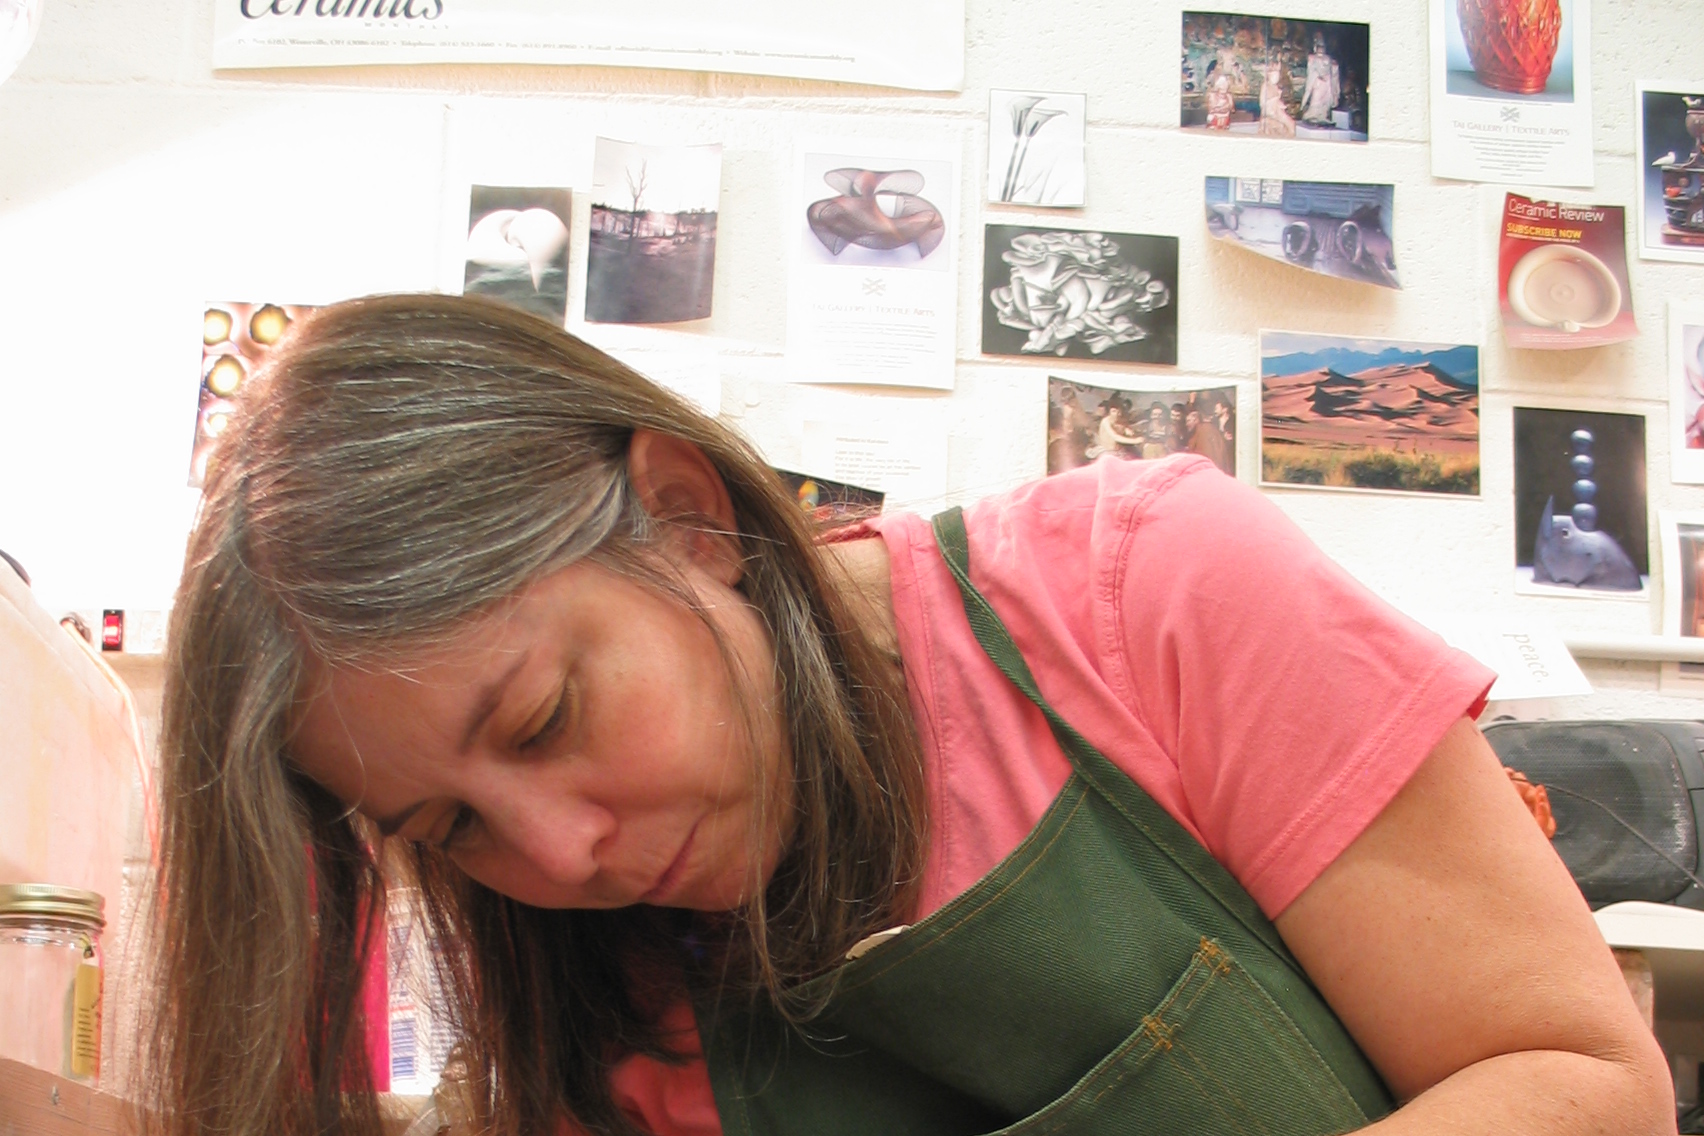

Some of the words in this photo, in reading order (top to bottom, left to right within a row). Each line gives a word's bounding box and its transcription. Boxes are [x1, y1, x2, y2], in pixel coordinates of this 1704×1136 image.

[1508, 198, 1557, 219] Ceramic
[1558, 206, 1605, 222] Review
[1506, 222, 1557, 237] SUBSCRIBE
[1559, 229, 1583, 239] NOW
[1502, 634, 1549, 683] peace.
